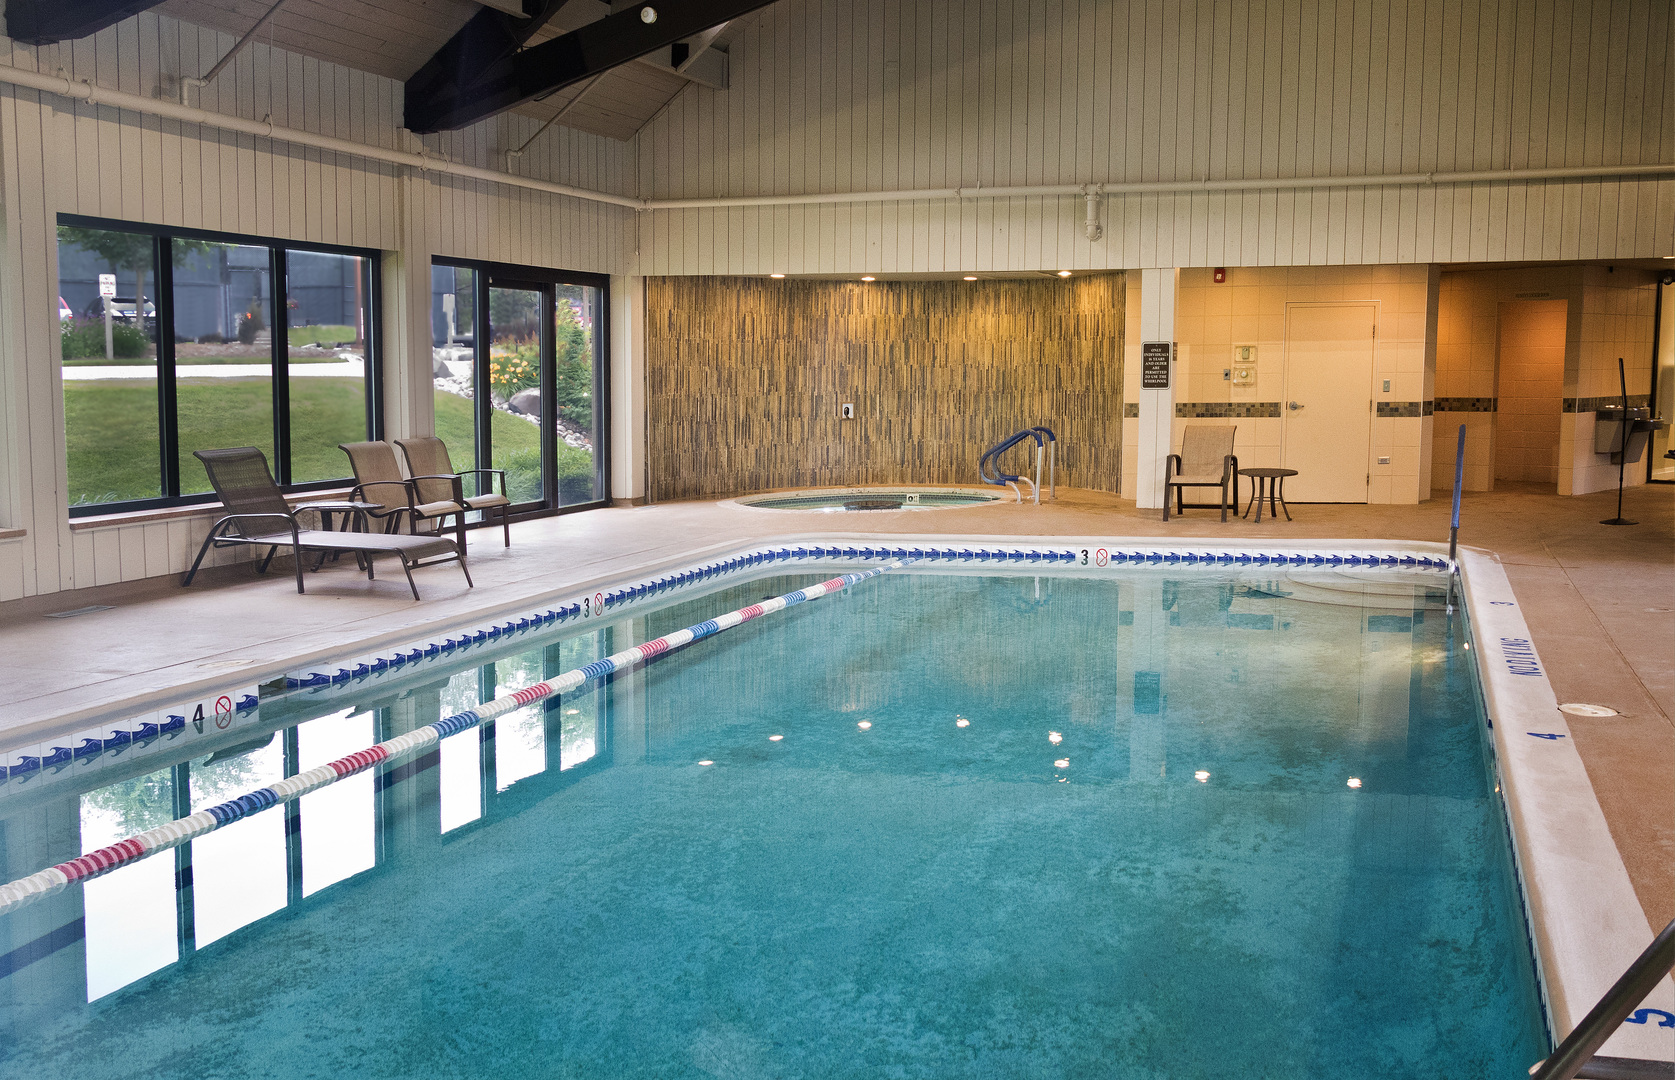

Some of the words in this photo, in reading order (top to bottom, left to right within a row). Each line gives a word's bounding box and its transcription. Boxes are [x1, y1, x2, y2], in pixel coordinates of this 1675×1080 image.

[1081, 549, 1089, 565] 3
[584, 597, 590, 617] 3
[192, 703, 205, 722] 4
[1526, 732, 1566, 740] 4
